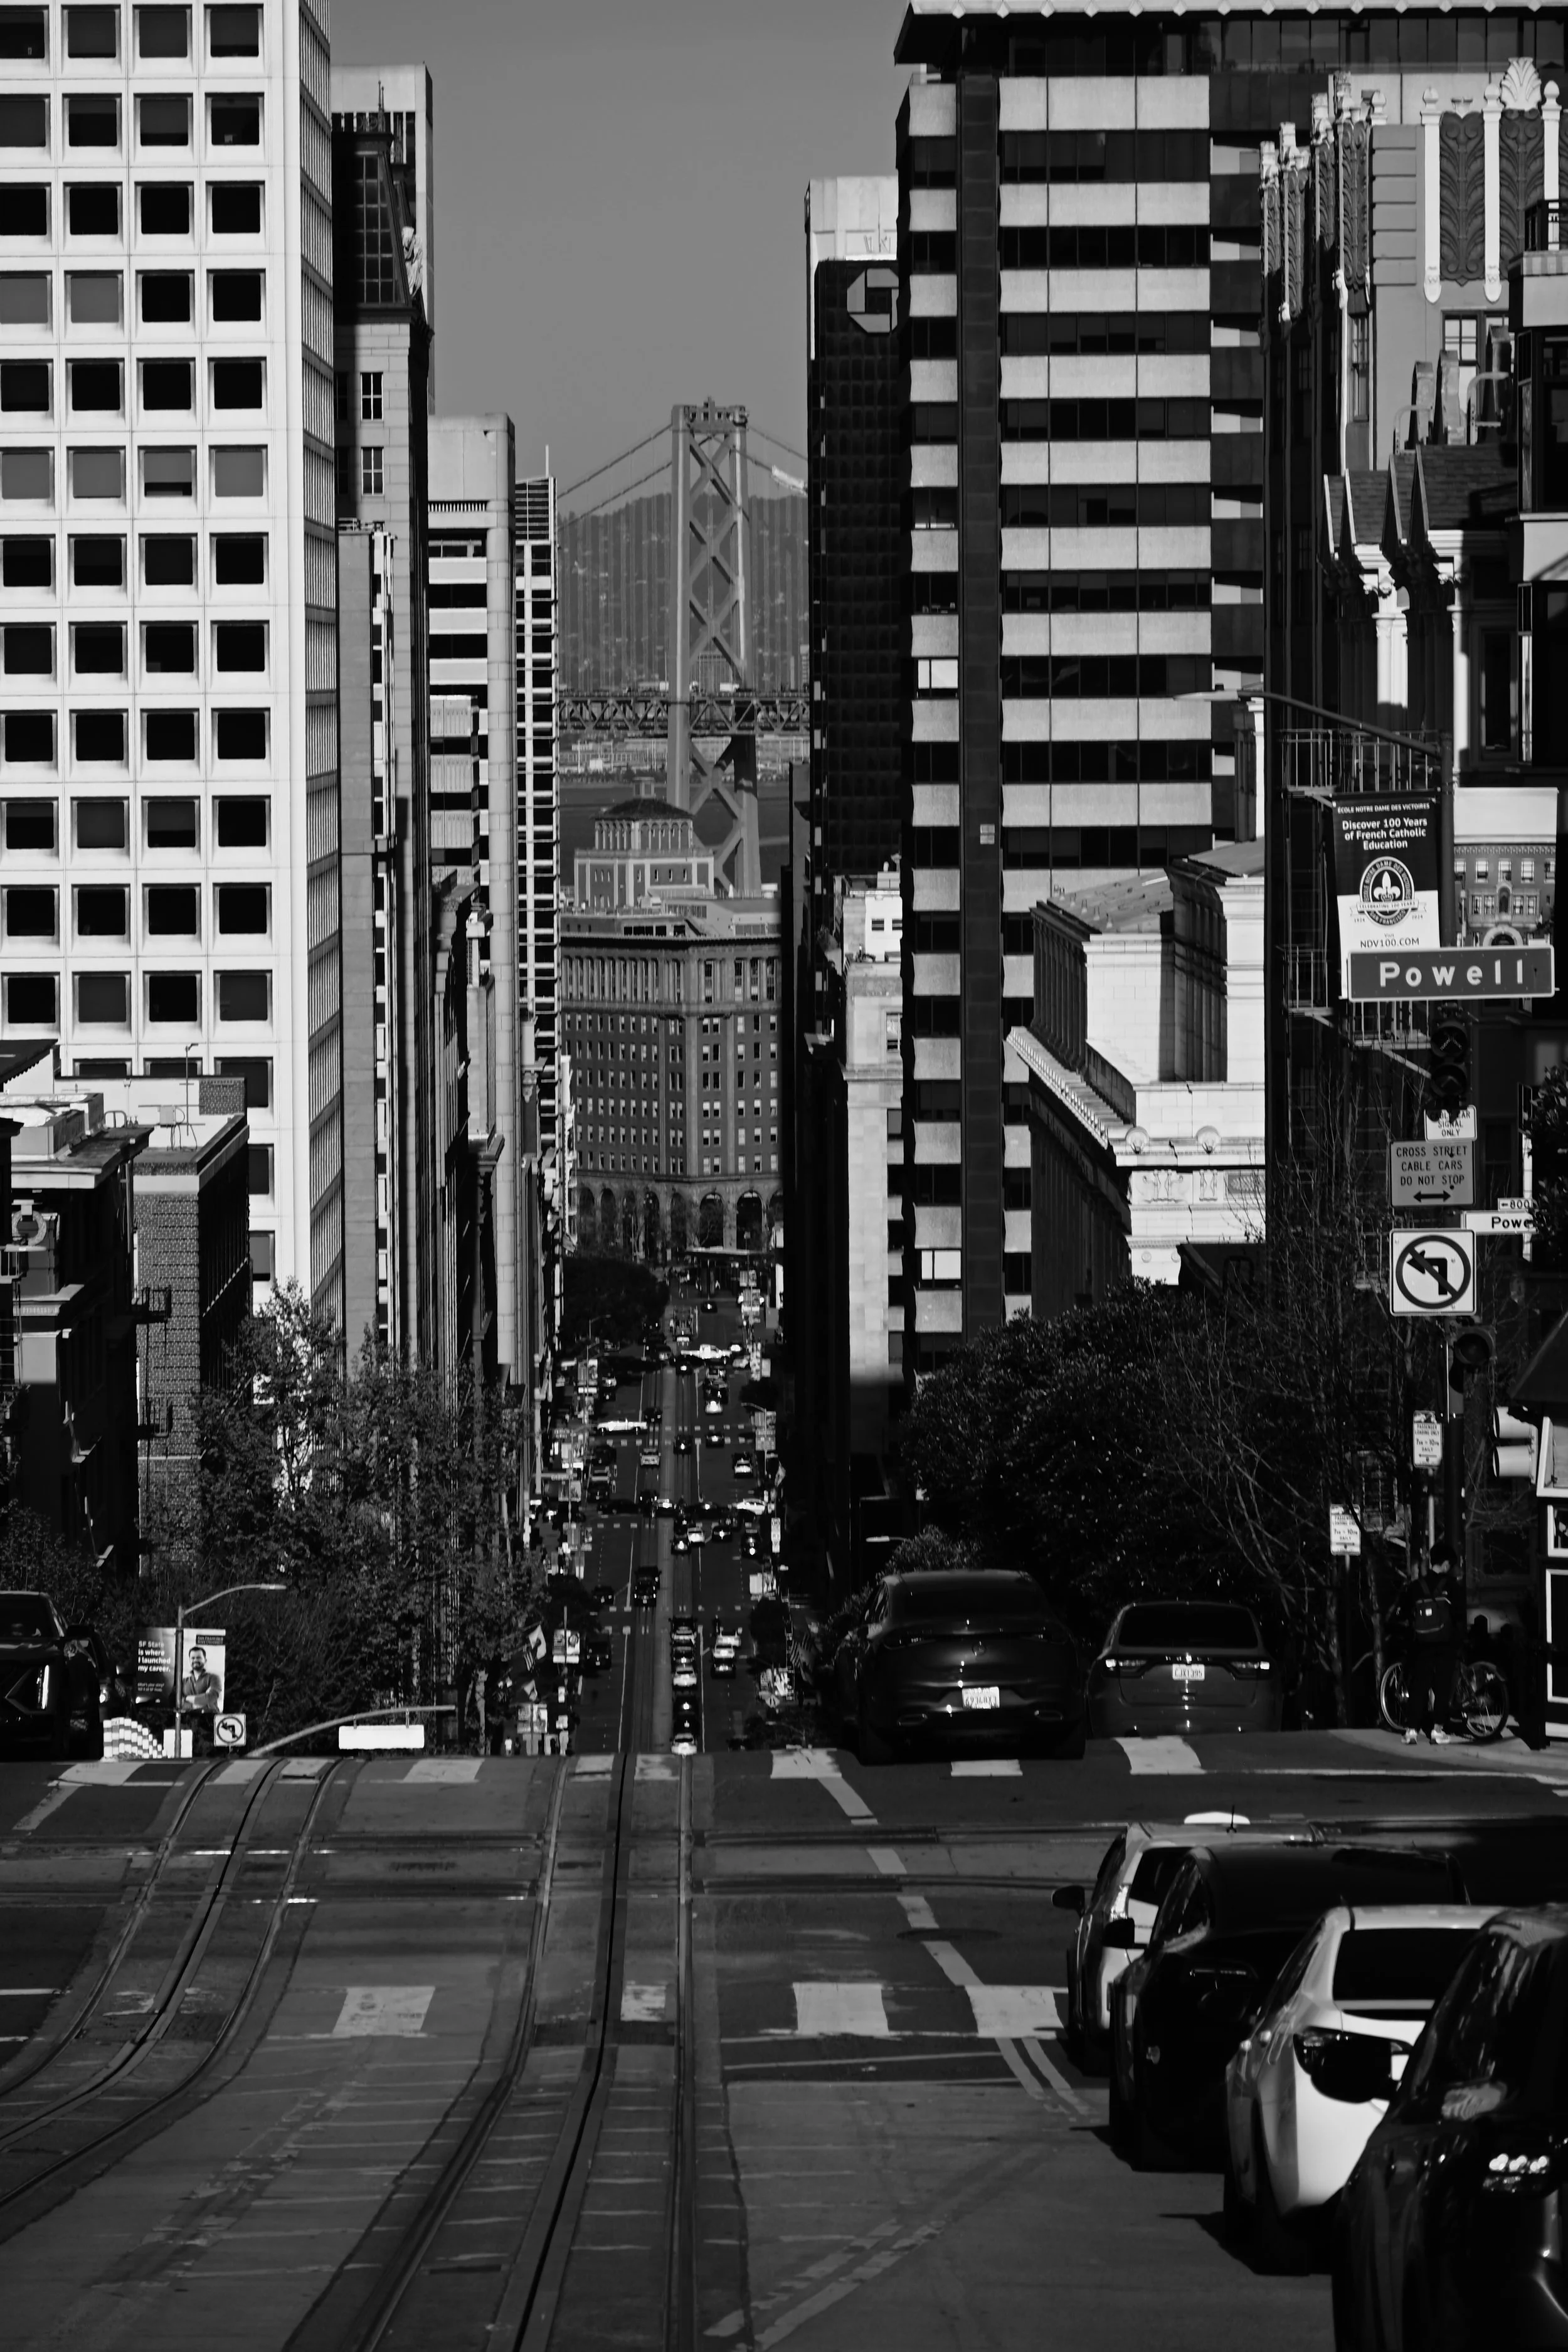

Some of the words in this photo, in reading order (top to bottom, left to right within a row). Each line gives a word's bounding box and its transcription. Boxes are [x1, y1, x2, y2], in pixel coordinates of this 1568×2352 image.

[1342, 820, 1380, 830] Discover
[1384, 817, 1401, 828] 100
[1403, 817, 1428, 827] Years
[1345, 831, 1353, 840] of
[1356, 829, 1386, 840] French
[1389, 827, 1426, 839] Catholic
[1363, 839, 1407, 850] Education
[1376, 860, 1392, 869] DAME
[1360, 937, 1420, 949] NDV100.COM
[1379, 958, 1523, 988] Powell
[1438, 1120, 1463, 1129] SIGNAL
[1396, 1147, 1426, 1158] CROSS
[1433, 1145, 1468, 1157] STREET
[1401, 1160, 1431, 1172] CABLE
[1438, 1160, 1463, 1171] CARS
[1401, 1175, 1412, 1186] DO
[1418, 1175, 1435, 1185] NOT
[1442, 1174, 1465, 1185] STOP
[1510, 1199, 1530, 1209] 800
[138, 1640, 147, 1648] SF
[147, 1640, 164, 1648] State
[142, 1656, 171, 1664] launched
